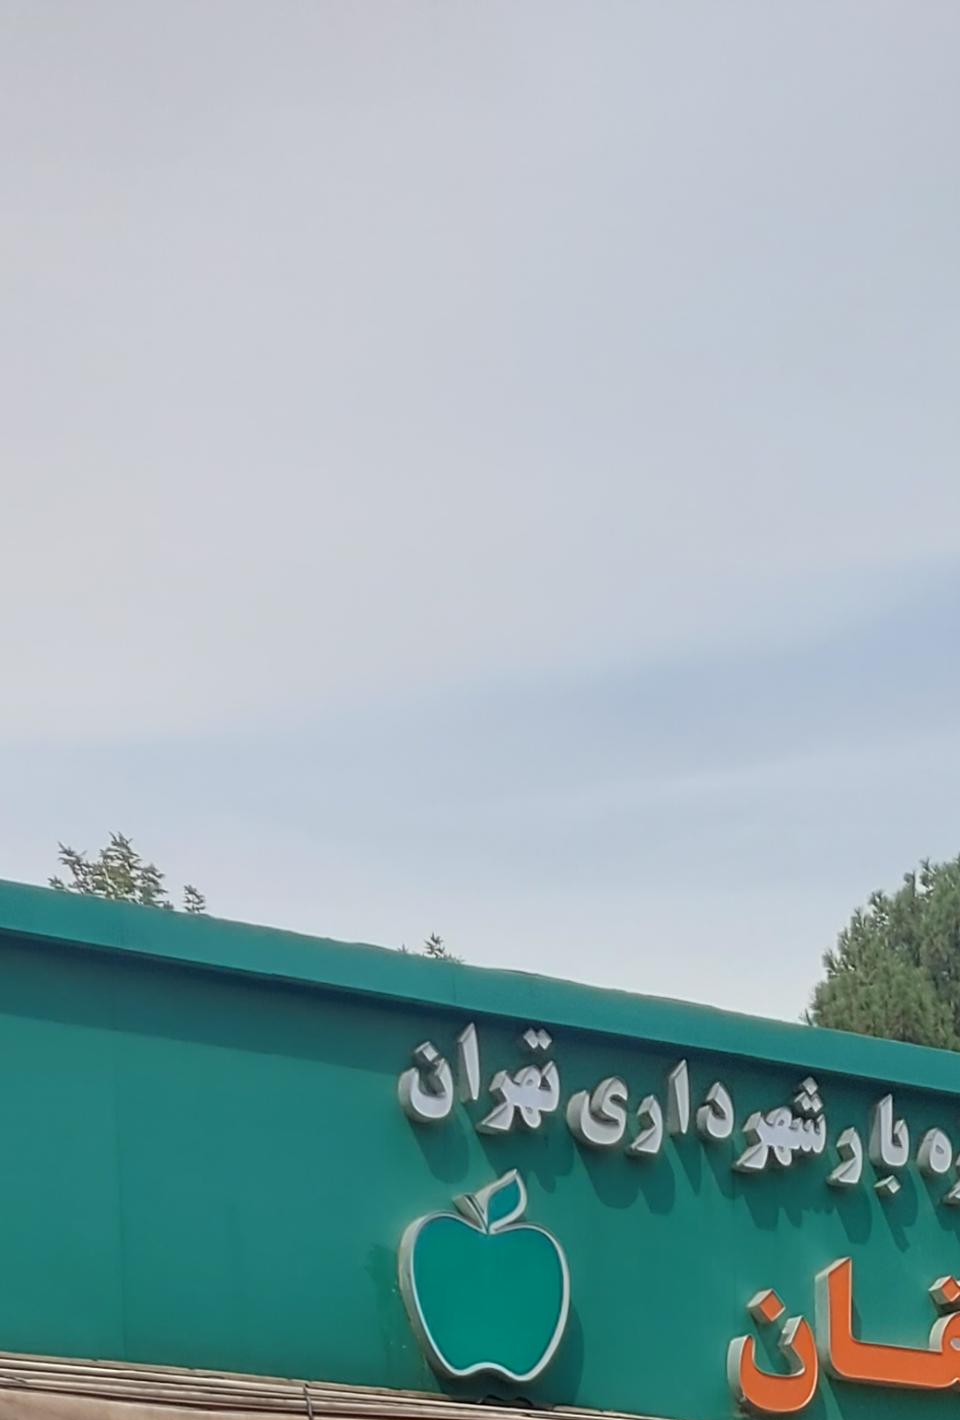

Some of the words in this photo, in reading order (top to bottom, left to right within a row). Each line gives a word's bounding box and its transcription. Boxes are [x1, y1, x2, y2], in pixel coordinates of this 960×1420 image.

[398, 1021, 561, 1135] تهران
[566, 1058, 828, 1174] شهرداری
[826, 1092, 910, 1200] بار
